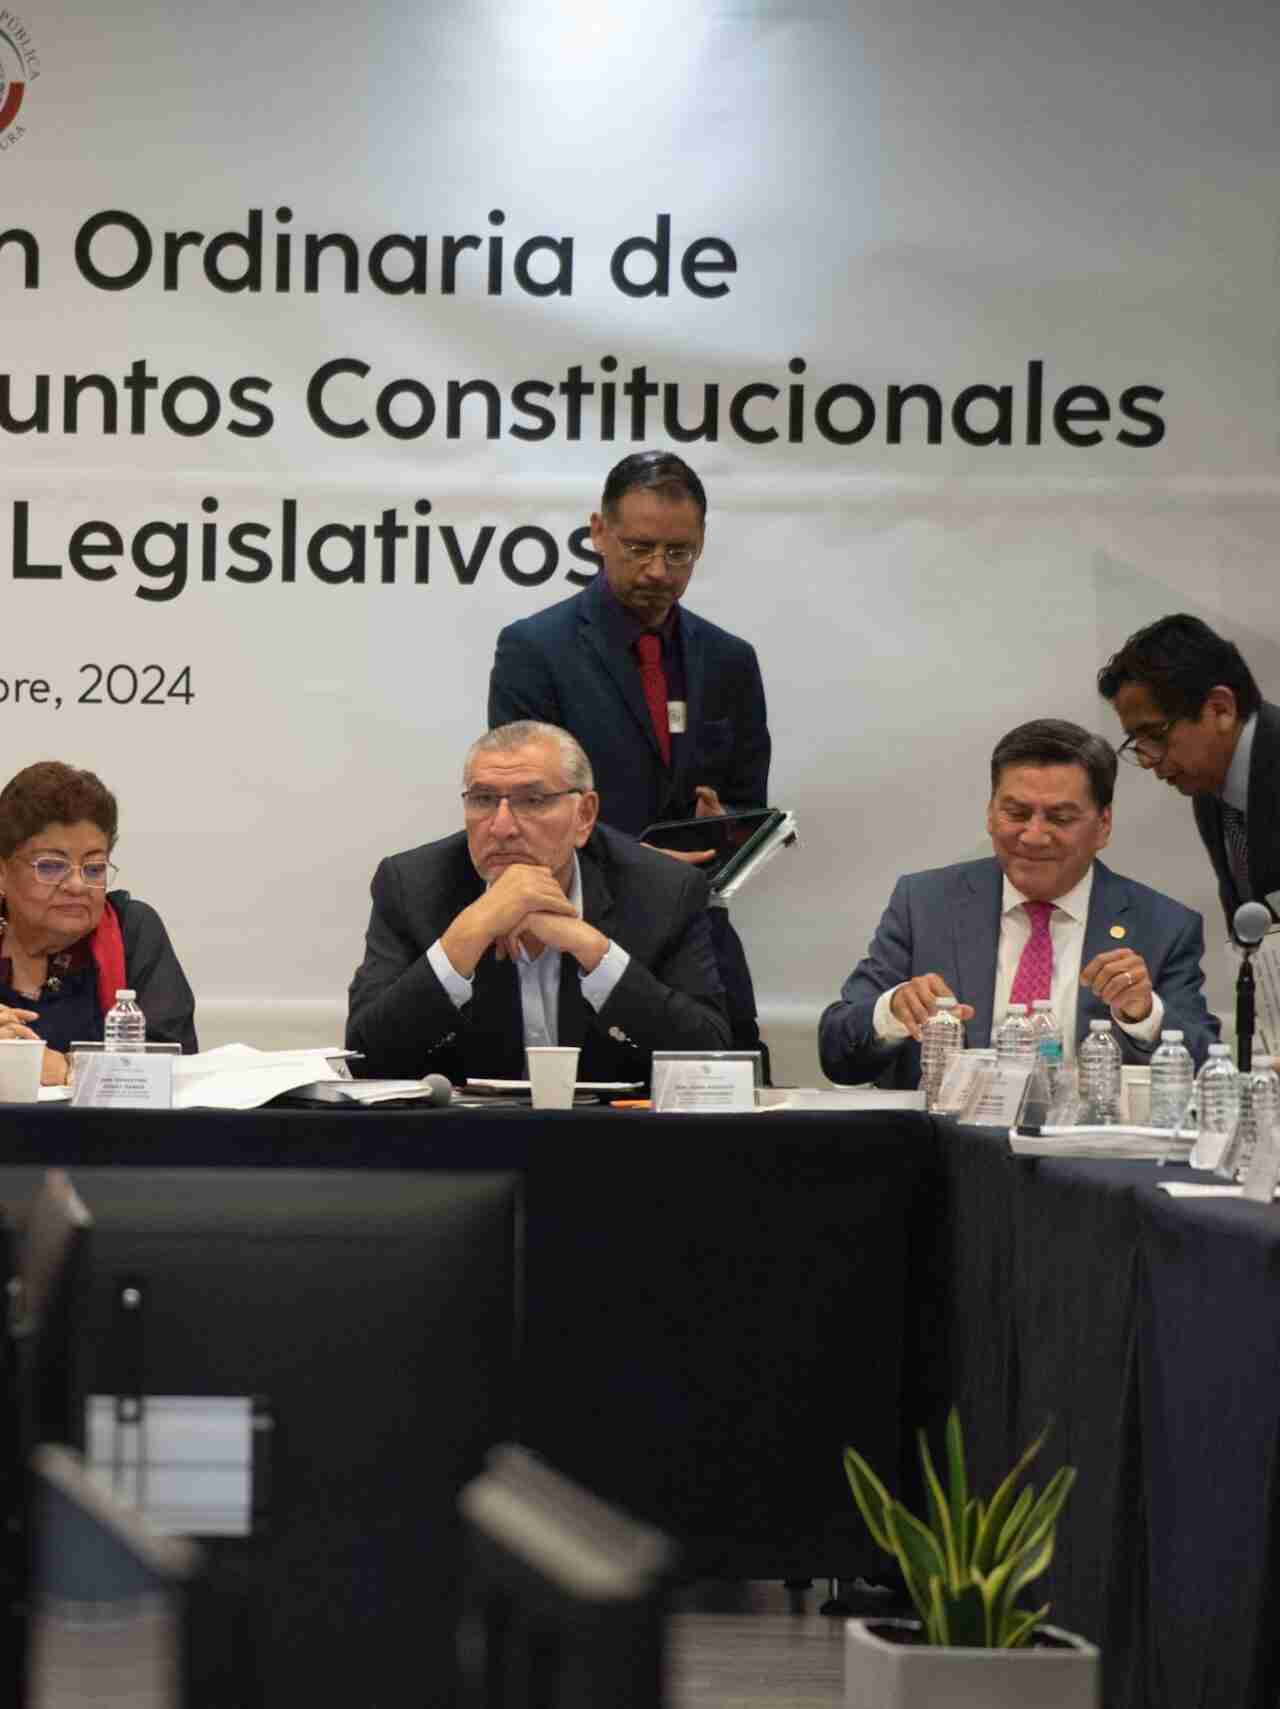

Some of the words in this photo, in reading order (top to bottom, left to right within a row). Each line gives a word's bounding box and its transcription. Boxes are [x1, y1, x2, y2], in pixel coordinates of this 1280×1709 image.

[75, 207, 573, 296] Ordinaria
[611, 215, 736, 298] de
[307, 355, 1166, 448] Constitucionales
[13, 497, 605, 601] Legislativos
[78, 664, 195, 705] 2024
